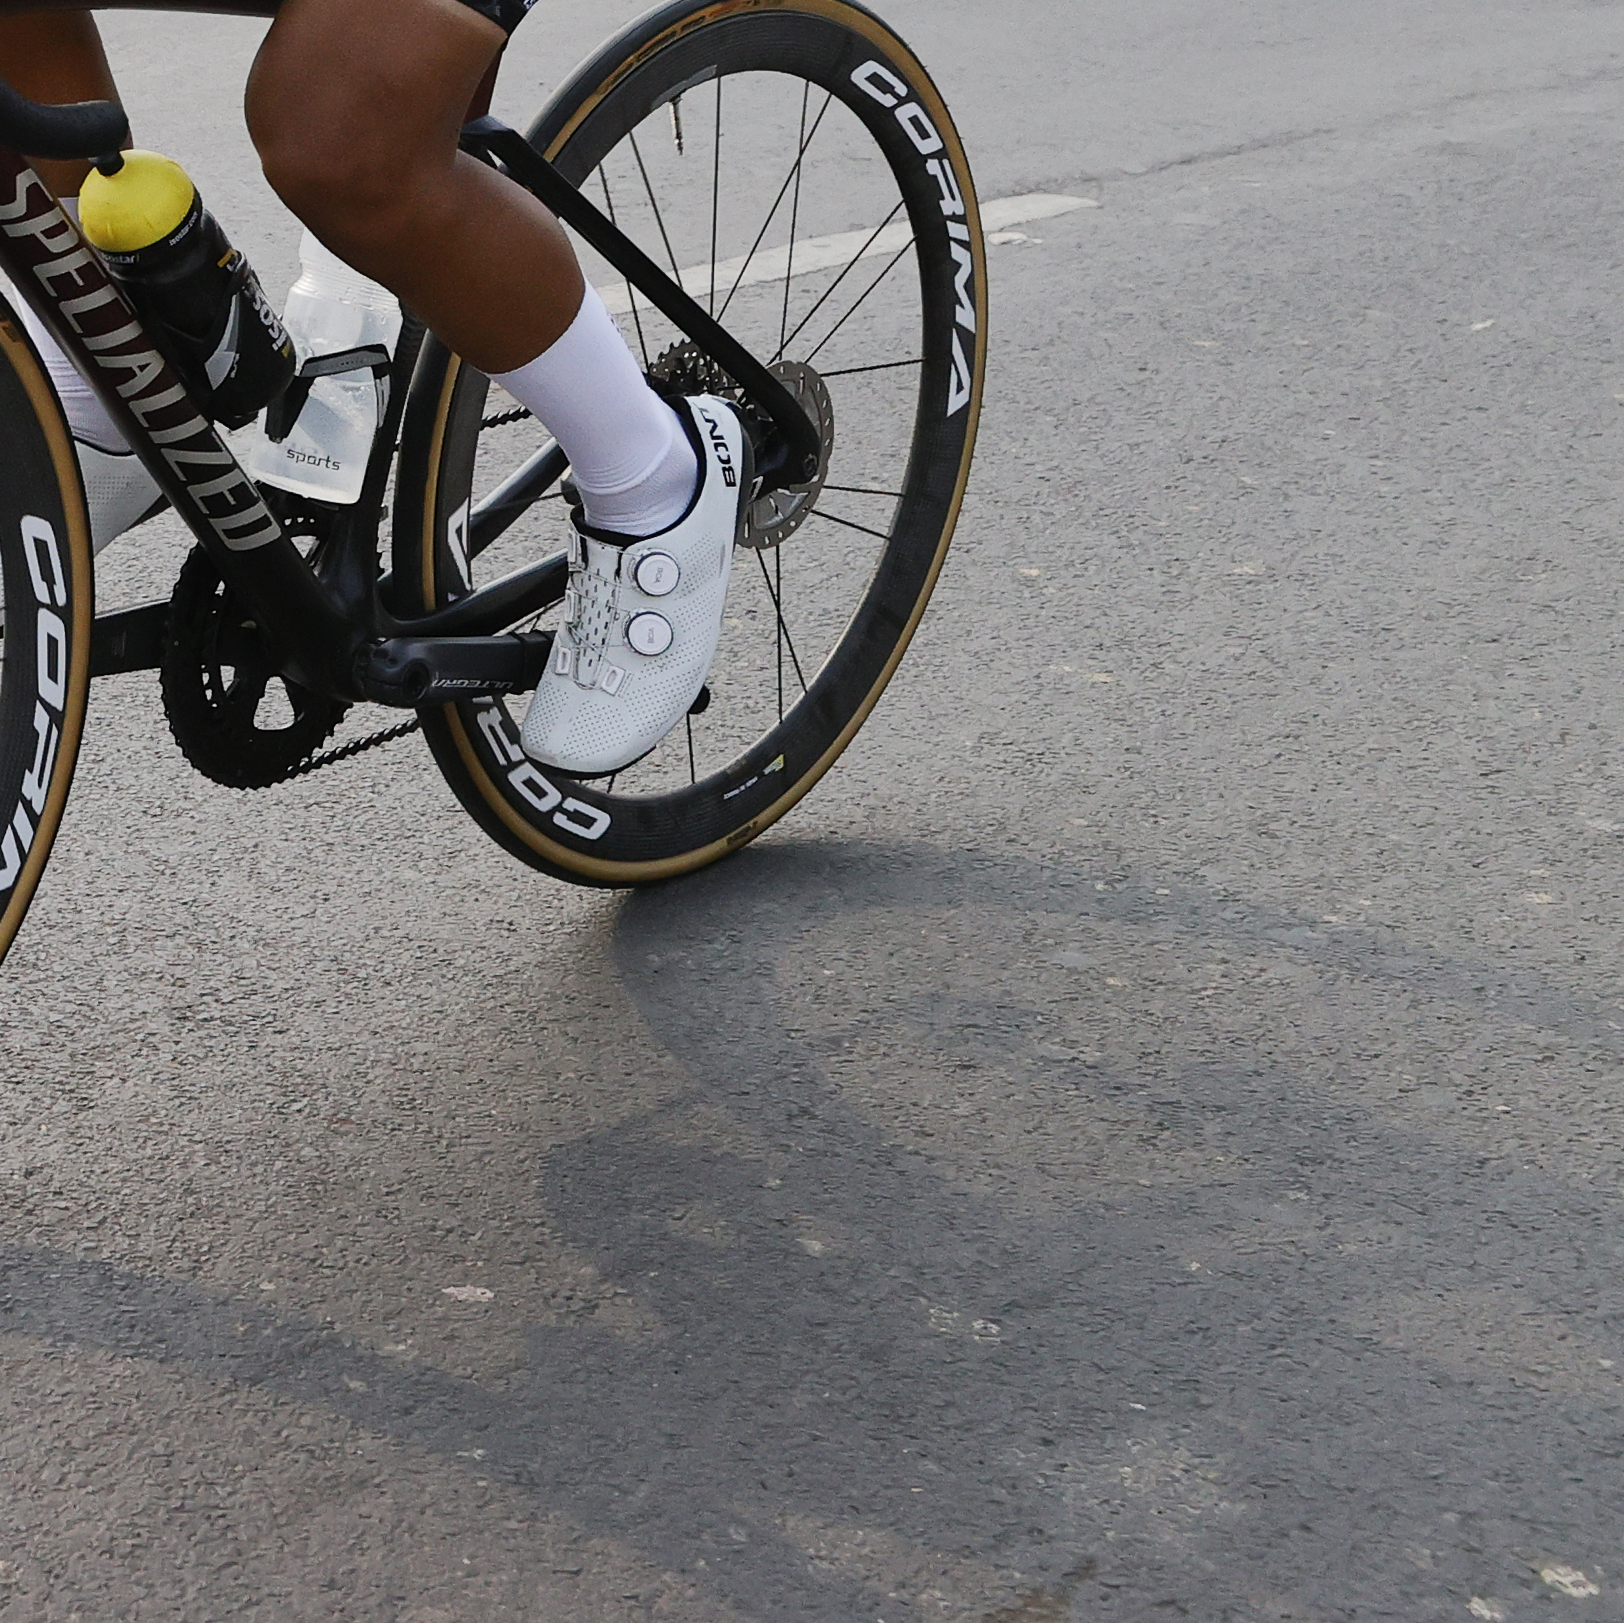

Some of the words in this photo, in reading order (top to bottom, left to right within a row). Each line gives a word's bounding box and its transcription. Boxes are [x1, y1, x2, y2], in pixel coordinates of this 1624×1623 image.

[849, 59, 972, 419] CORIMA
[287, 448, 341, 471] sports
[700, 406, 737, 488] BONT
